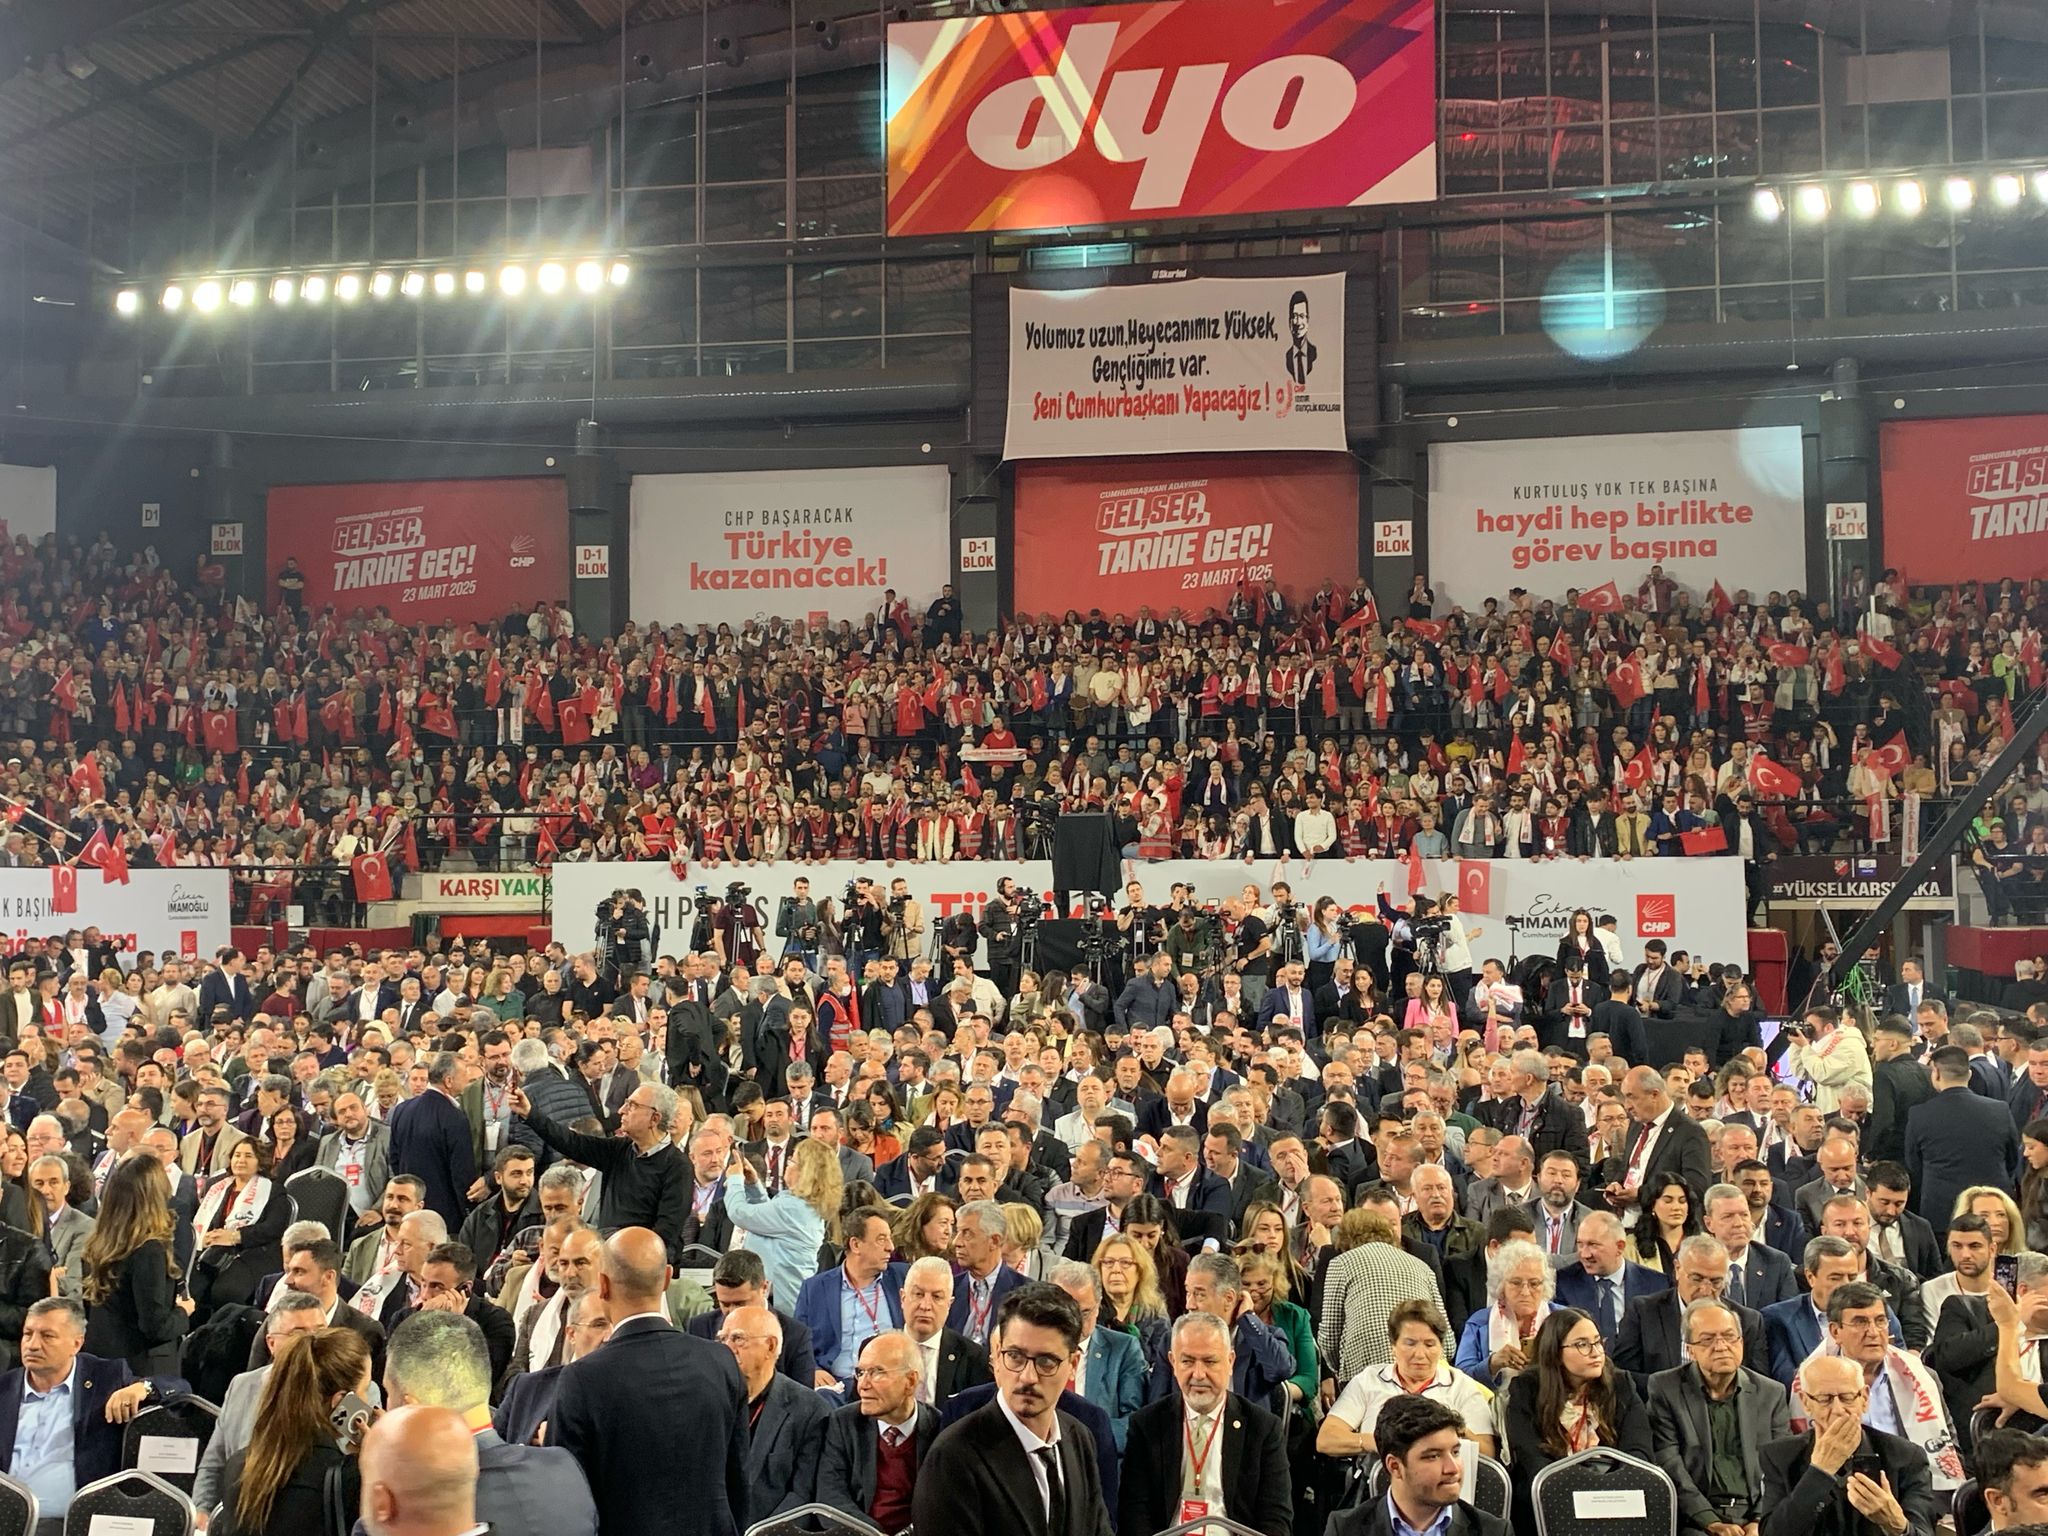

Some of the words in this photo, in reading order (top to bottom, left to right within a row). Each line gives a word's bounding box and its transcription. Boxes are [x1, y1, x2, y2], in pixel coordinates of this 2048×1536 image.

[966, 21, 1357, 210] dyo
[1025, 321, 1086, 350] Yolumuz
[1224, 310, 1278, 341] Yüksek,
[1092, 352, 1175, 391] Gençliğimiz
[1179, 353, 1210, 376] var.
[1033, 391, 1062, 421] Seni
[1066, 387, 1180, 421] Cumhurbaşkanı
[1513, 482, 1588, 500] KURTULUŞ
[1595, 482, 1622, 497] YOK
[1629, 480, 1655, 495] TEK
[1662, 478, 1718, 495] BAŞINA
[145, 509, 159, 521] D1
[725, 510, 754, 527] CHP
[762, 507, 854, 528] BAŞARACAK
[1476, 503, 1561, 538] haydi
[1571, 506, 1628, 533] hep
[1637, 499, 1753, 528] birlikte
[1836, 507, 1858, 519] D-1
[218, 526, 236, 537] D-1
[1383, 525, 1404, 537] D-1
[213, 540, 241, 551] BLOK
[724, 529, 853, 565] Türkiye
[969, 541, 988, 553] D-1
[1202, 523, 1273, 563] GEÇ!
[1376, 540, 1411, 553] BLOK
[1512, 538, 1602, 569] görev
[1611, 536, 1717, 563] başına
[418, 544, 477, 580] GEÇ!
[510, 557, 535, 568] CHP
[583, 549, 602, 561] D-1
[963, 555, 994, 569] BLOK
[577, 563, 607, 576] BLOK
[690, 557, 887, 590] kazanacak!
[1181, 572, 1199, 589] 23
[1200, 567, 1238, 587] MART
[402, 588, 416, 602] 23
[418, 583, 448, 600] MART
[449, 580, 477, 596] 2025
[168, 900, 209, 913] İMAMOĞLU
[1641, 922, 1671, 933] CHP
